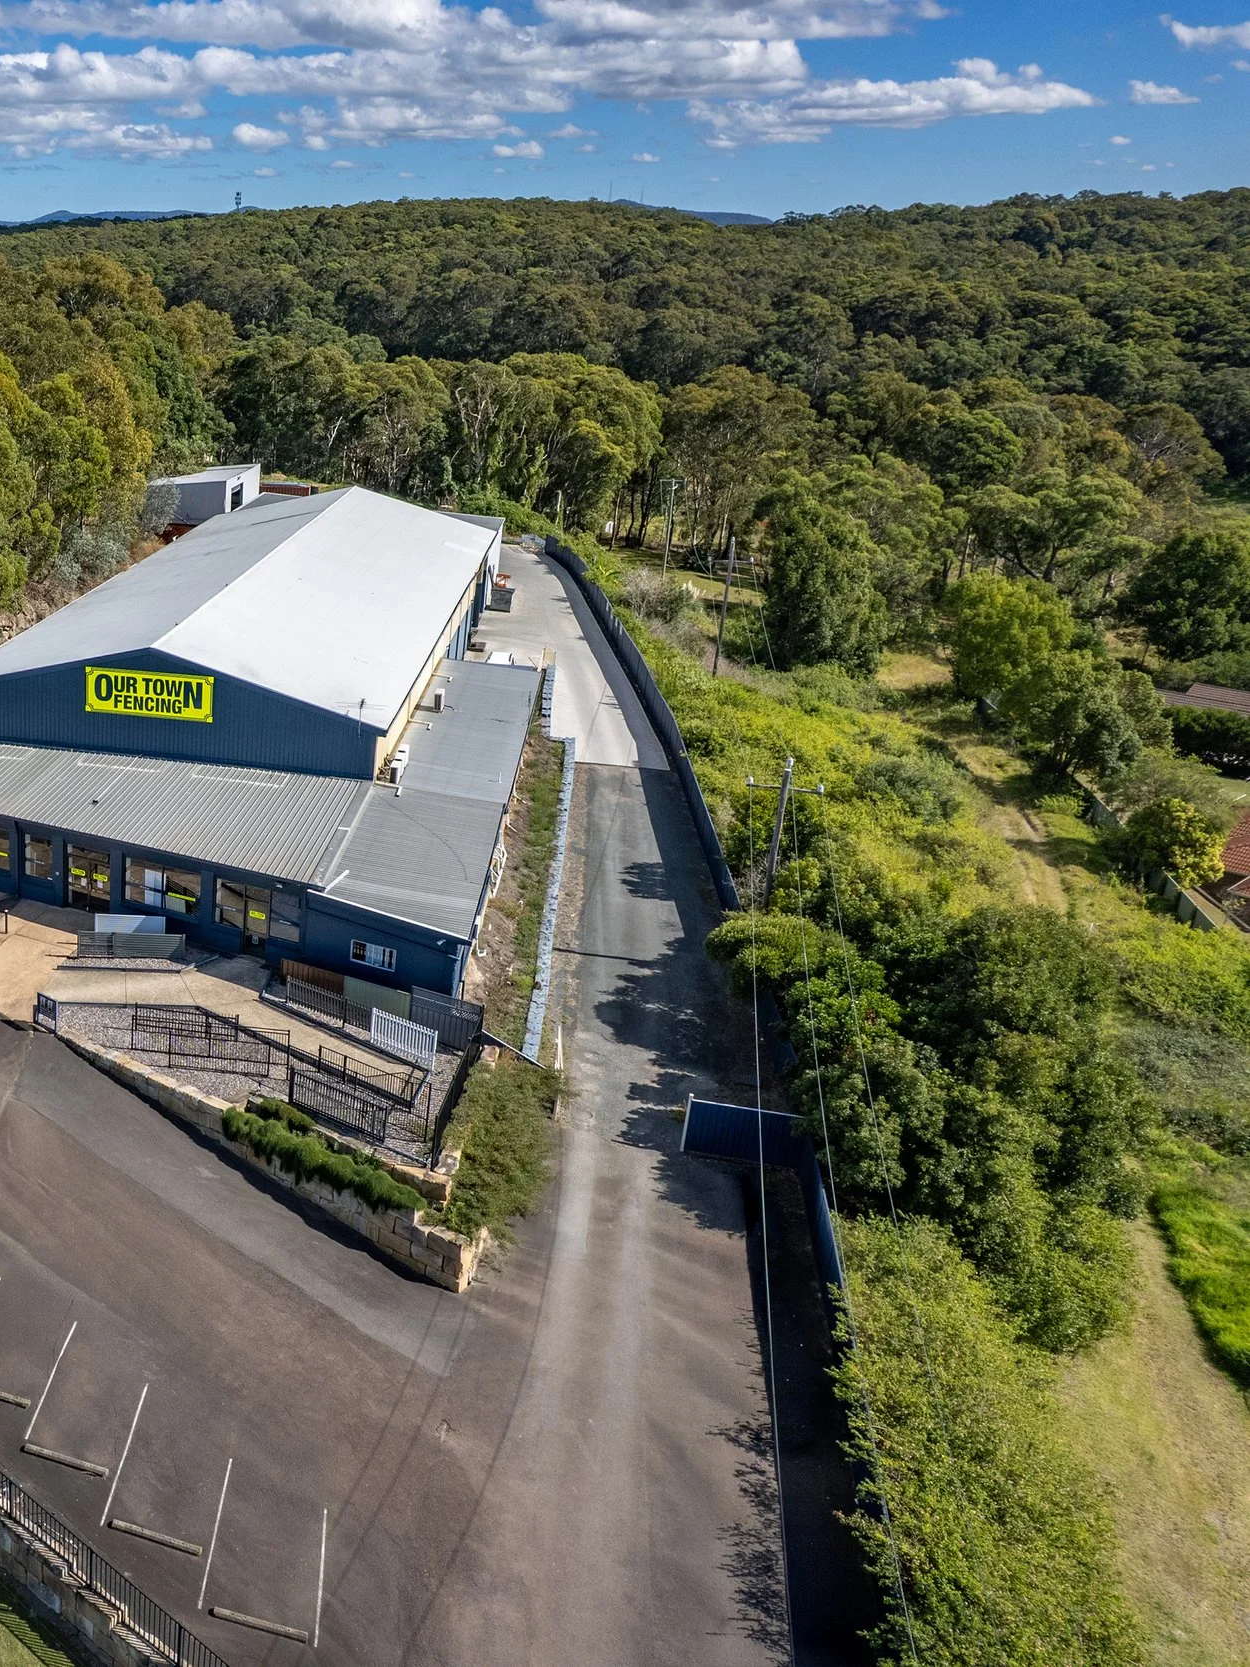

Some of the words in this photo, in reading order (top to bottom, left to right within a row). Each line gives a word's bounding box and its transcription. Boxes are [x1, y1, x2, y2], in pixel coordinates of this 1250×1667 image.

[94, 674, 137, 701] OUR
[142, 678, 203, 709] TOWN
[113, 694, 183, 714] FENCING
